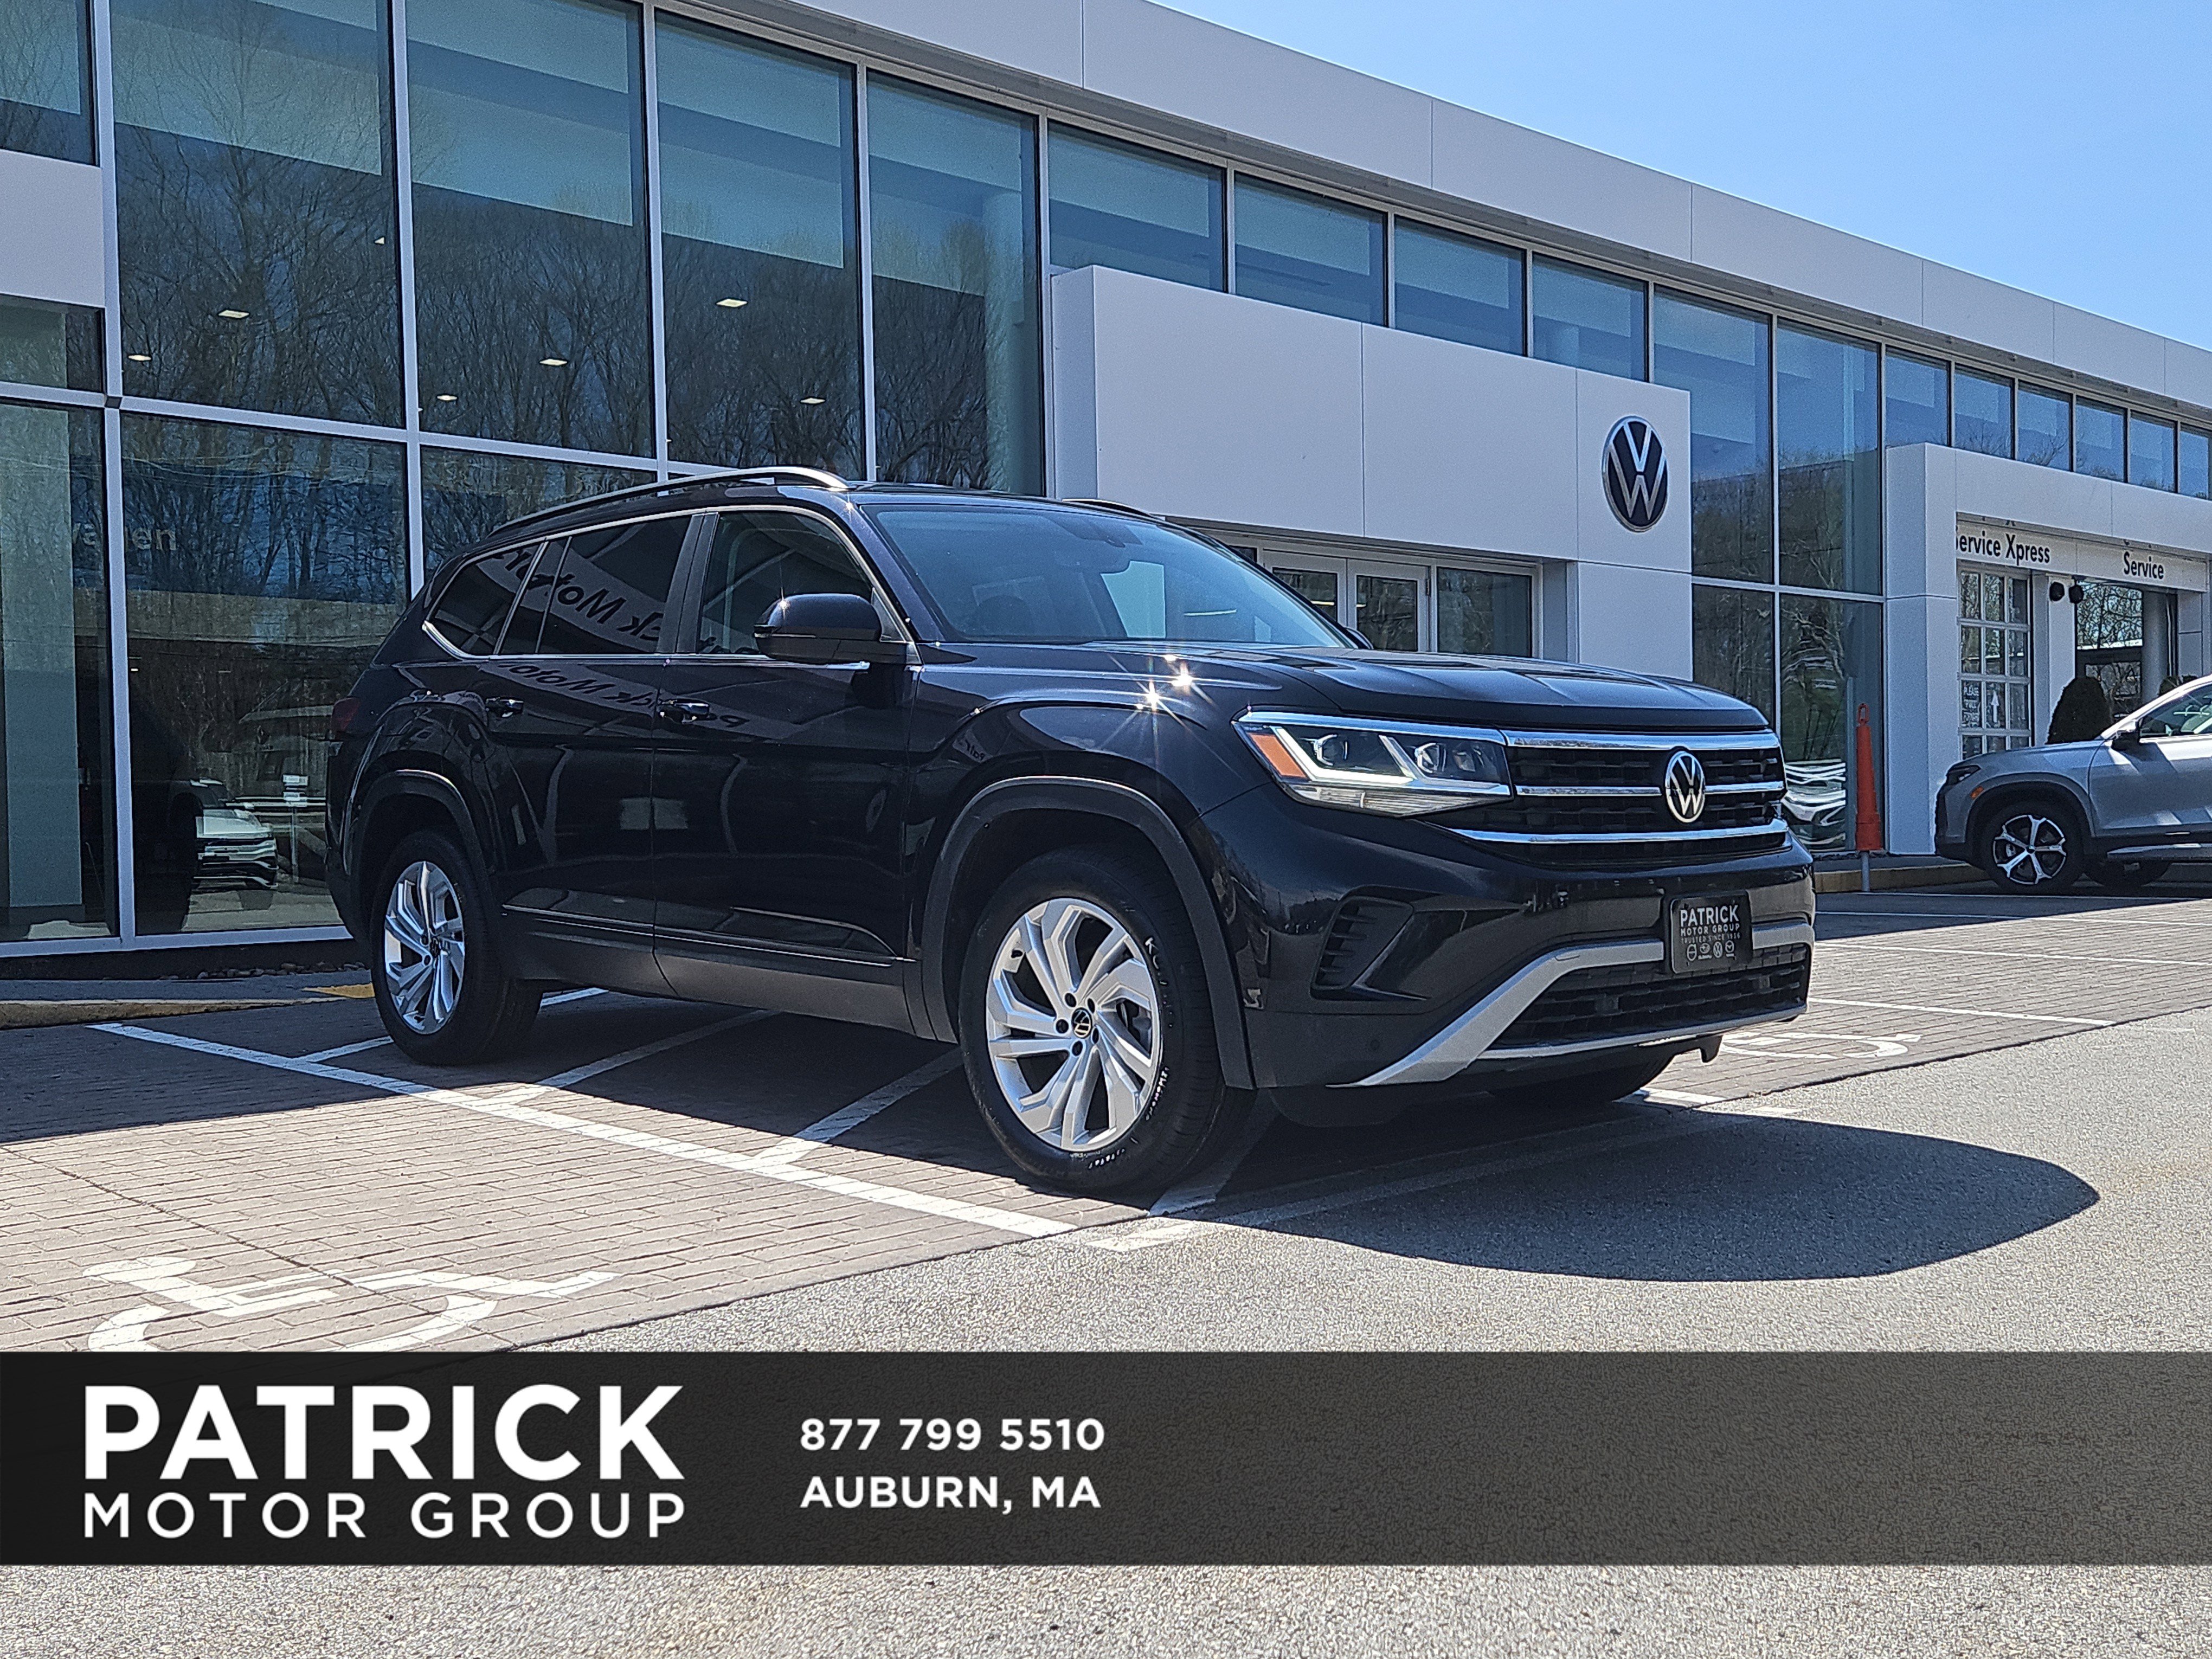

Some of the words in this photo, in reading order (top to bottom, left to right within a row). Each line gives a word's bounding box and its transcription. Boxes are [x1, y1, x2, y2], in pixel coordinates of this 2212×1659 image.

[1956, 530, 2001, 557] ervice
[2005, 533, 2050, 566] Xpress
[2124, 551, 2164, 580] Service
[1681, 905, 1739, 927] PATRICK
[1681, 925, 1708, 936] MOTOR
[1712, 923, 1740, 933] GROUP
